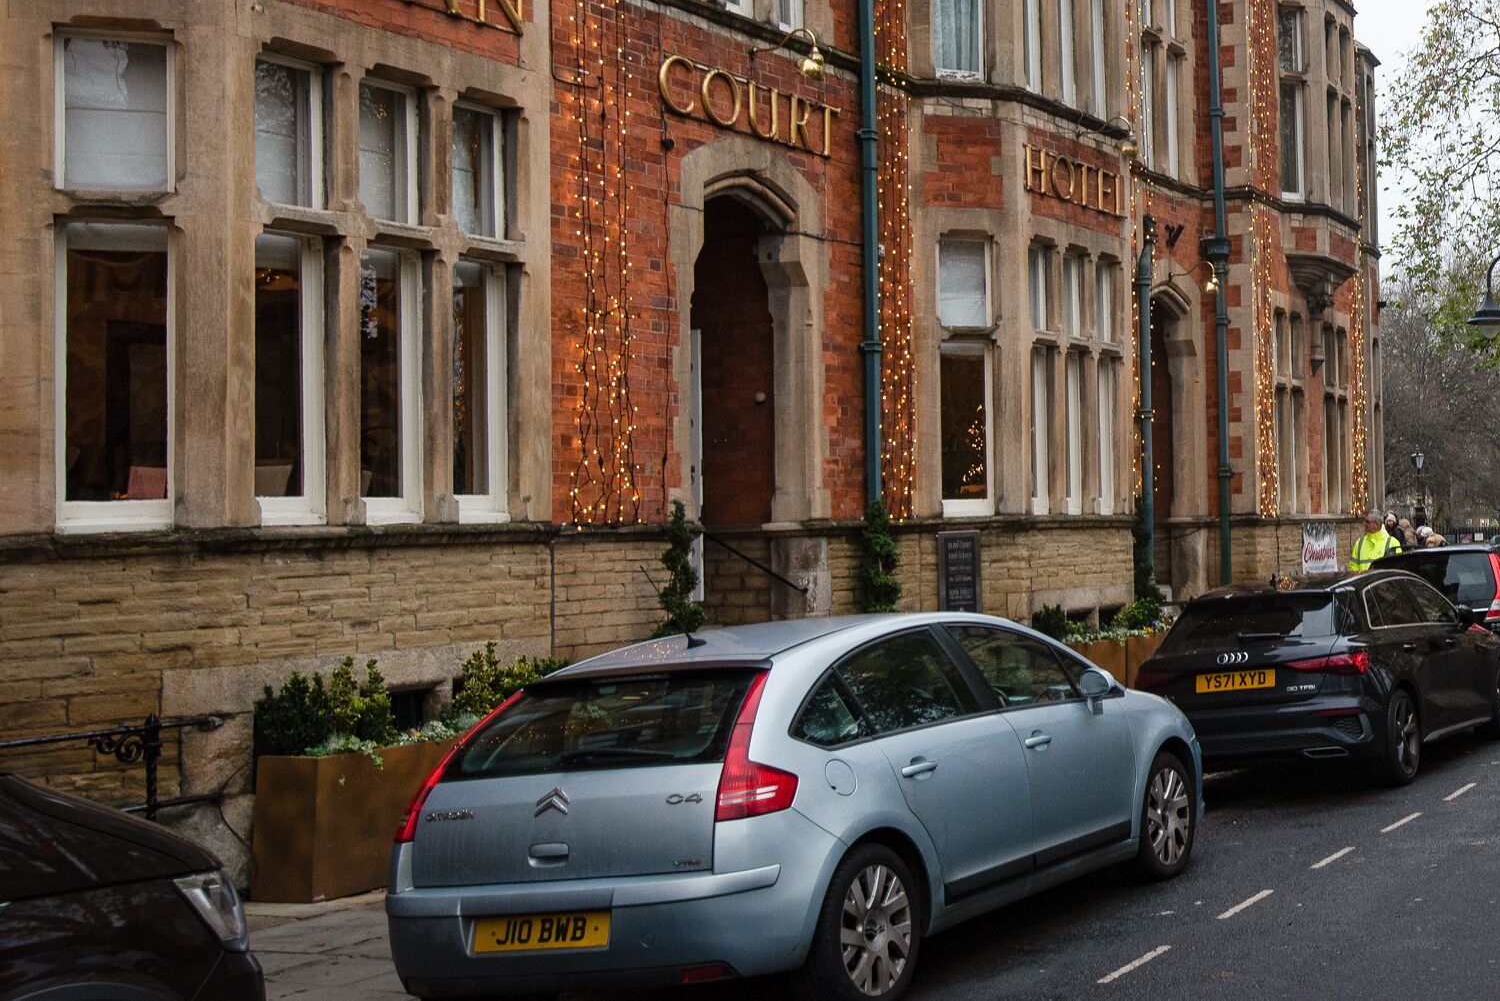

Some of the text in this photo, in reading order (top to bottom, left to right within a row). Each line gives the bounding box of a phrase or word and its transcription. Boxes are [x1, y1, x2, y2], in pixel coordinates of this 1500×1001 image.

[659, 55, 842, 158] COURT
[1023, 143, 1124, 218] HOTEL
[1205, 671, 1266, 690] YS71 XYD
[665, 792, 703, 805] C4
[496, 916, 588, 946] J10 BWB
